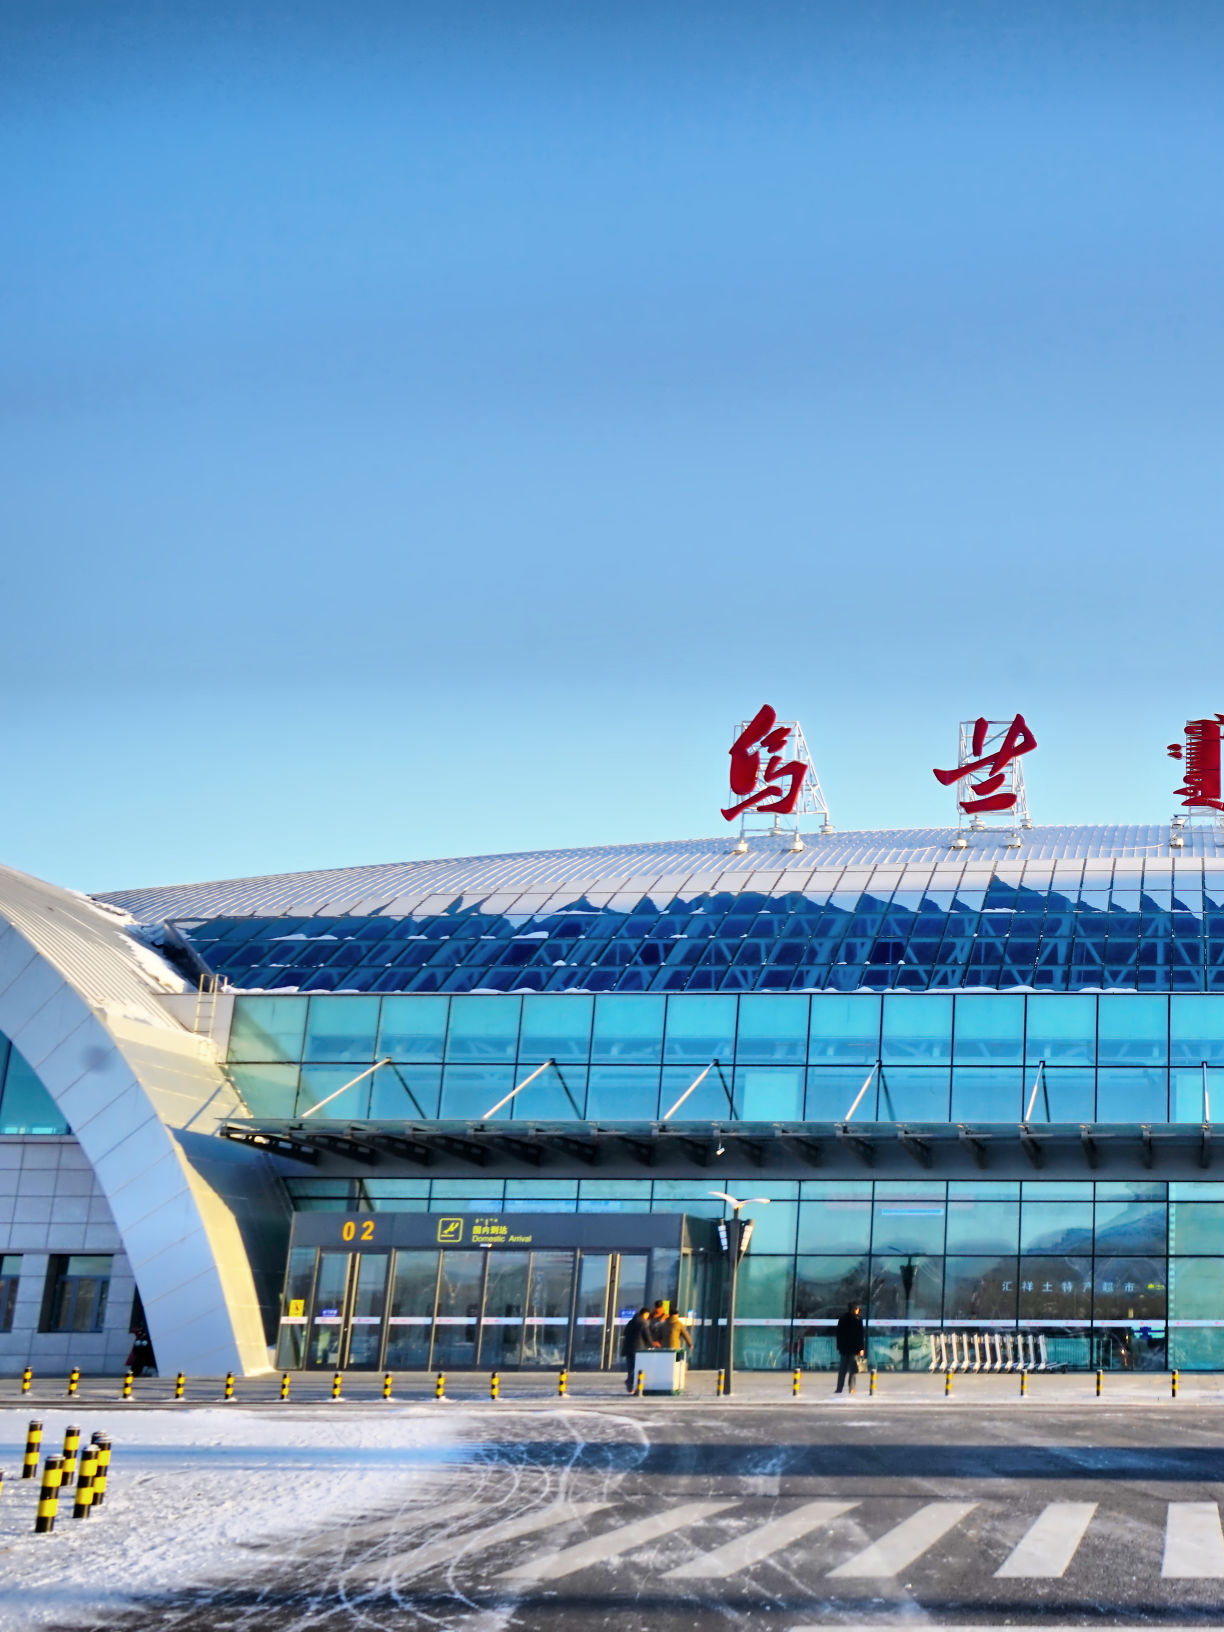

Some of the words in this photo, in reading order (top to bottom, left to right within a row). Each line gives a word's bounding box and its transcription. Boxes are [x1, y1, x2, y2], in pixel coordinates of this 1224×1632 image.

[472, 1235, 506, 1243] Domestic
[508, 1235, 532, 1243] Arrival
[1002, 1281, 1136, 1293] 汇祥土特产超市
